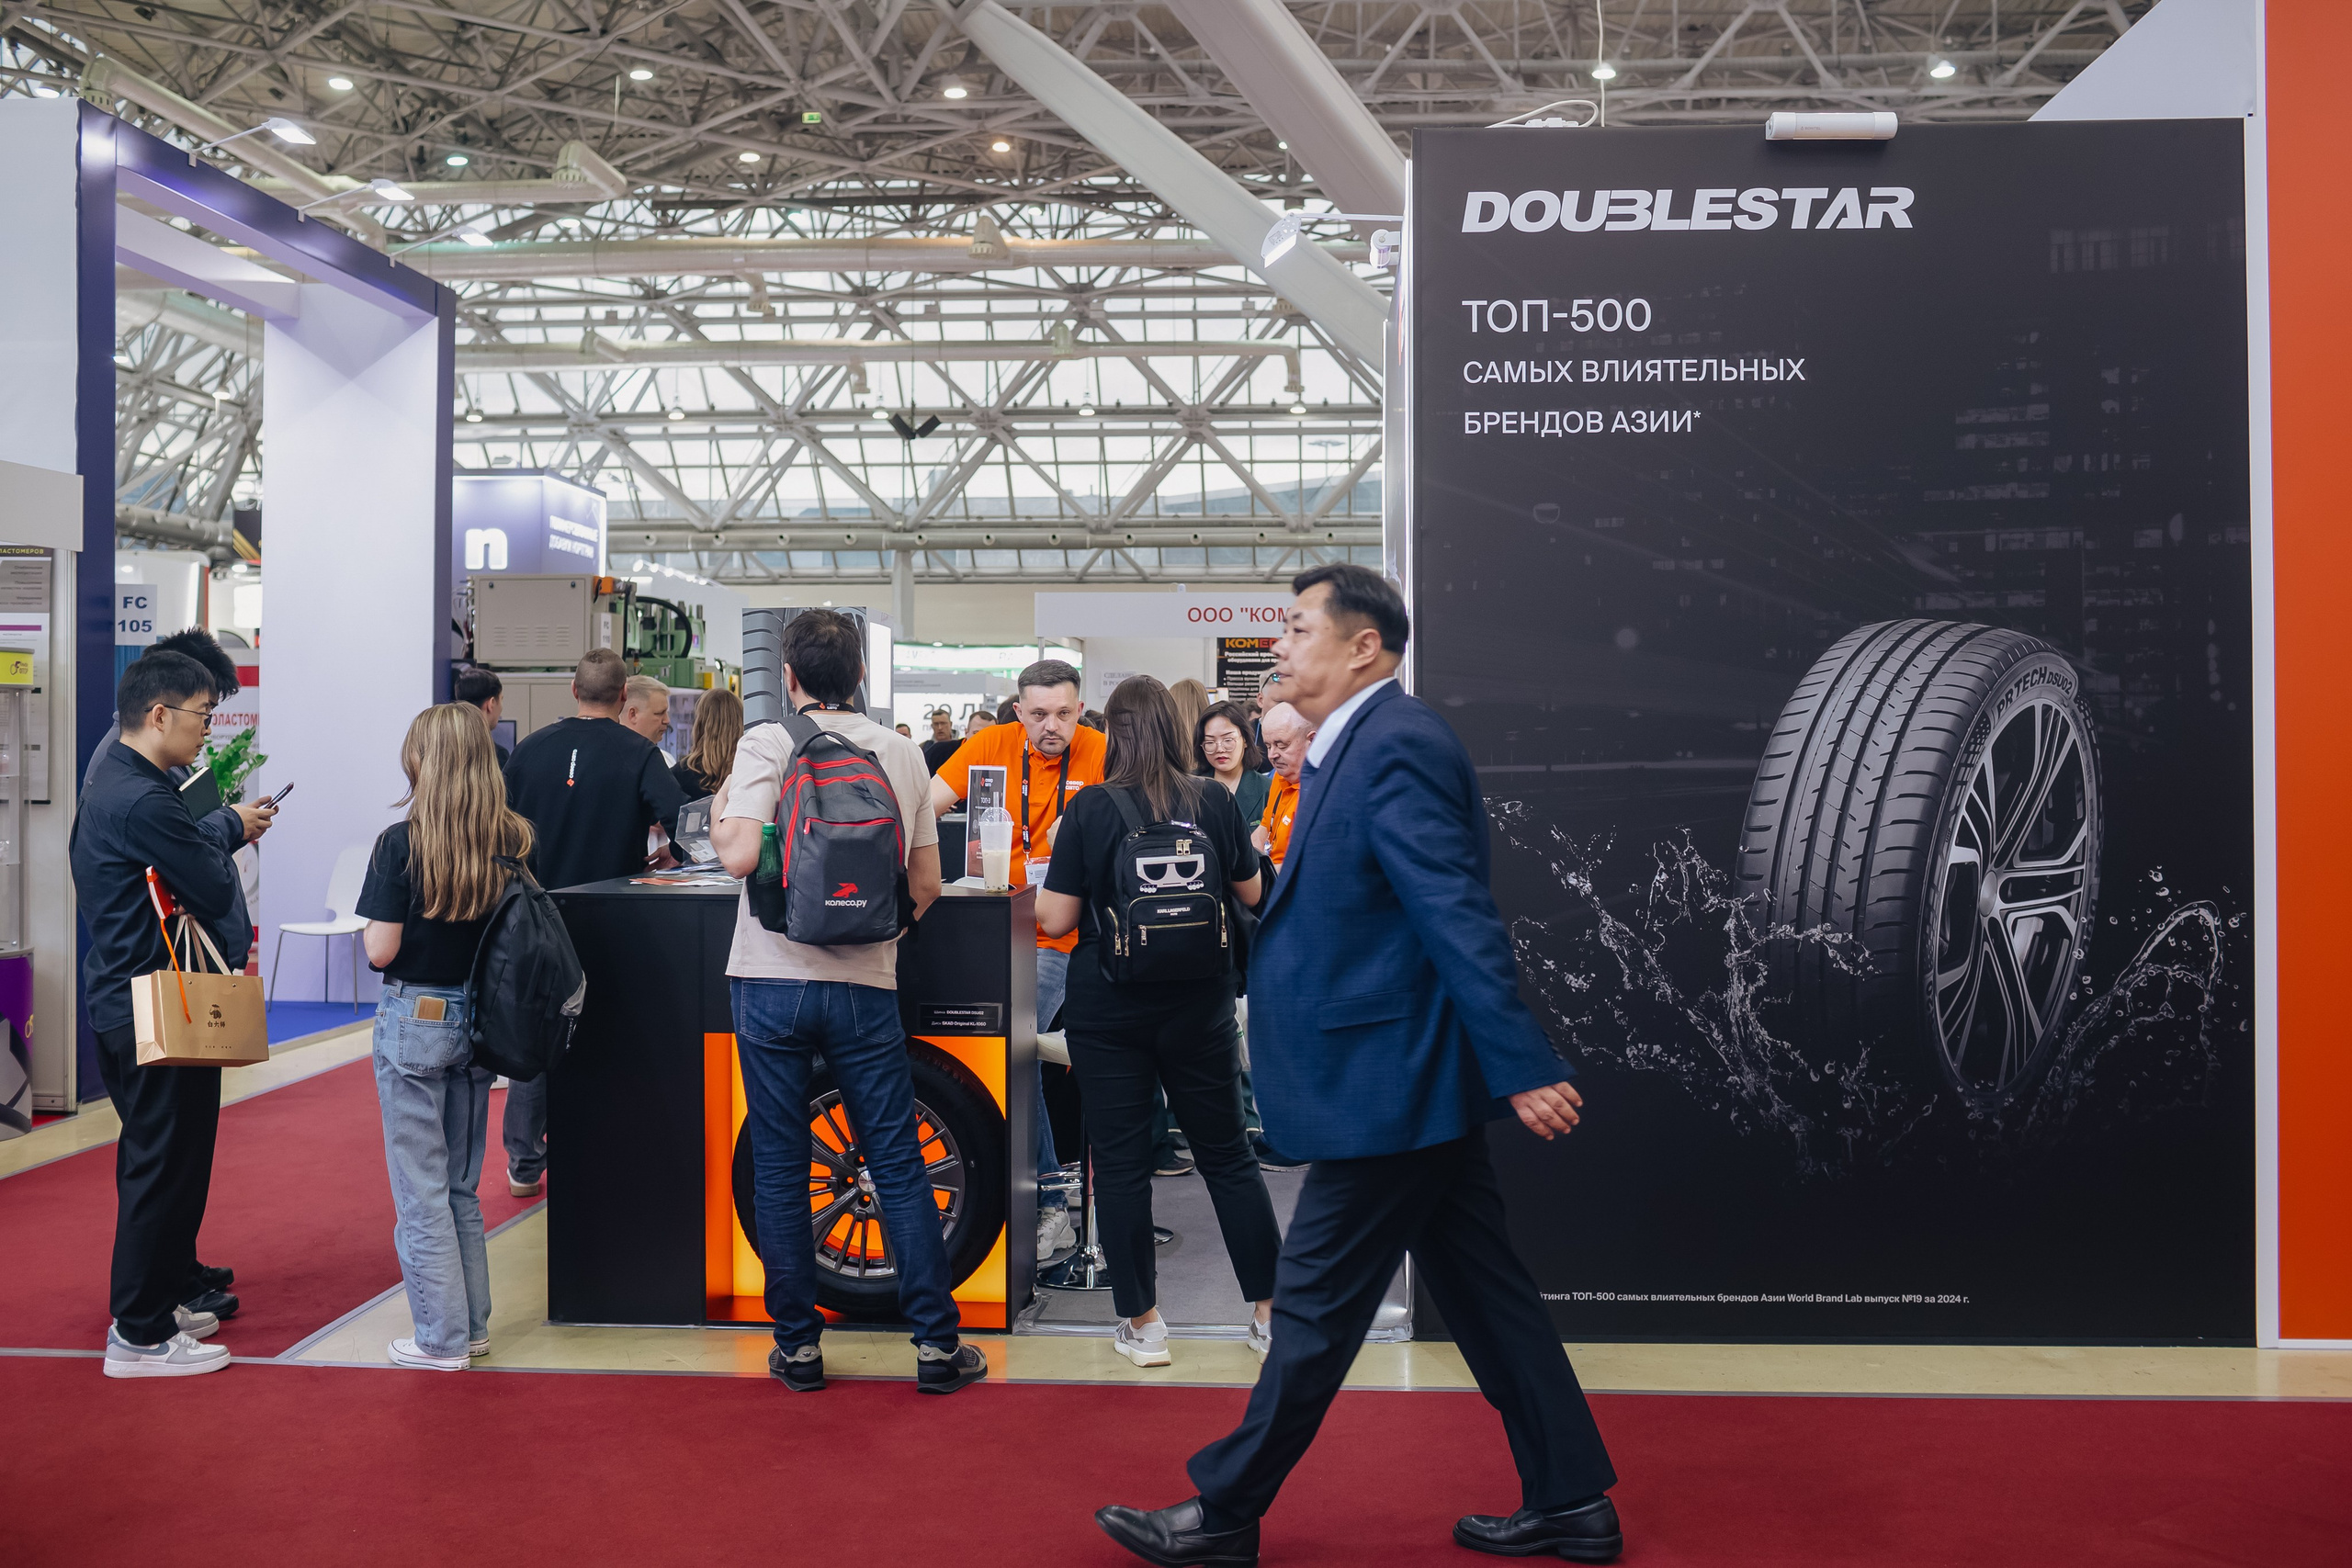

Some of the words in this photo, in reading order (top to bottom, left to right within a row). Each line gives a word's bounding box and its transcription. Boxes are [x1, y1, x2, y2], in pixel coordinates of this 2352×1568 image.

[1461, 186, 1916, 233] DOUBLESTAR
[1461, 298, 1652, 333] ТОП-500
[1463, 360, 1574, 384] САМЫХ
[1582, 358, 1806, 383] ВЛИЯТЕЛЬНЫХ
[1464, 411, 1604, 438] БРЕНДОВ
[122, 596, 148, 610] FC
[1187, 606, 1234, 623] ООО
[118, 619, 153, 633] 105
[2046, 671, 2074, 695] DSU02
[212, 713, 260, 726] ЭЛАСТОМ
[824, 899, 868, 908] колесо.ру
[1571, 1292, 1616, 1301] ТОП-500
[1616, 1293, 1649, 1302] самых
[1650, 1294, 1716, 1303] влиятельных
[1716, 1292, 1759, 1303] брендов
[1760, 1293, 1786, 1303] Азии
[1787, 1293, 1815, 1303] World
[1815, 1293, 1844, 1303] Brand
[1845, 1293, 1863, 1303] Lab
[1864, 1295, 1900, 1304] выпуск
[1901, 1294, 1923, 1303] №19
[1924, 1295, 1936, 1303] за
[1937, 1294, 1962, 1303] 2024
[1962, 1295, 1971, 1303] г.
